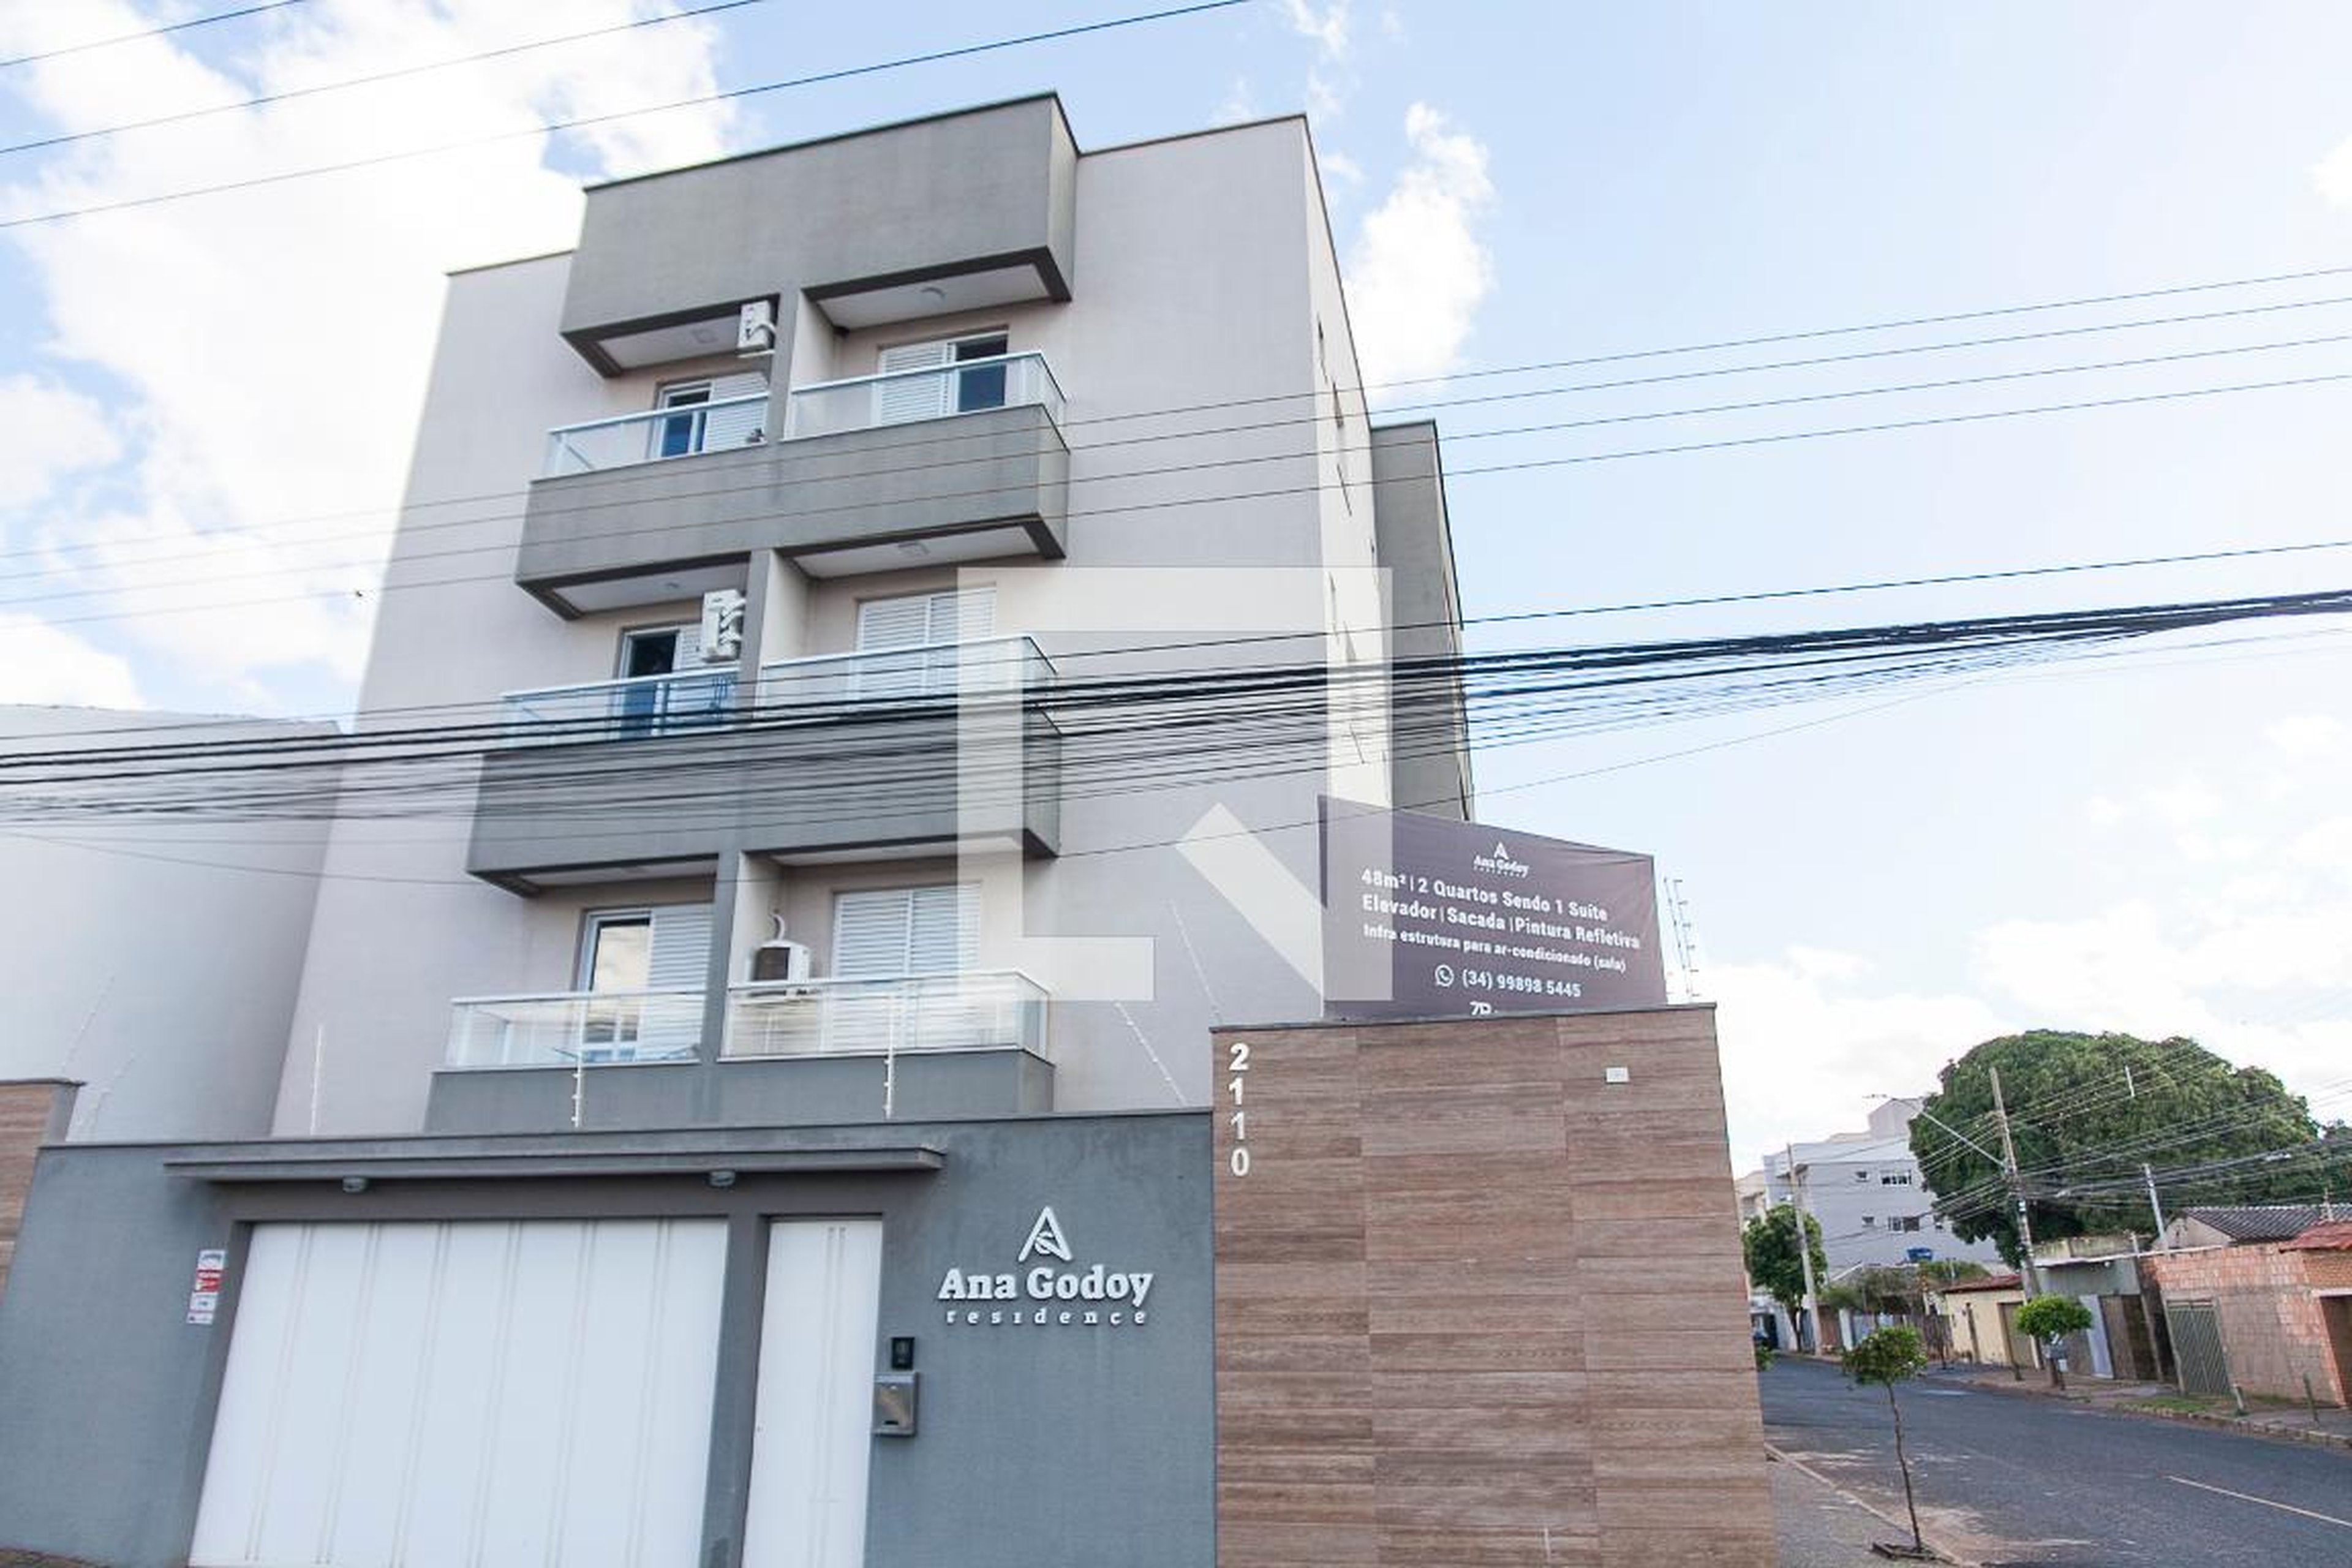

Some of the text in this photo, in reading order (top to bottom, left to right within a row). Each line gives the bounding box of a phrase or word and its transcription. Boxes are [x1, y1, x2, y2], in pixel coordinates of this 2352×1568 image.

[1418, 877, 1429, 893] 2
[1433, 880, 1498, 905] Quartos
[1502, 891, 1551, 912] Sendo
[1555, 899, 1562, 914] 1
[1363, 923, 1626, 973] Infra estrutura para ar-condicionado (sala)
[1575, 925, 1640, 949] Refletiva
[1463, 968, 1581, 997] (34) 99898 5445
[1227, 1042, 1250, 1177] 2110
[938, 1264, 1154, 1307] Ana Godoy
[946, 1308, 1145, 1325] residence
